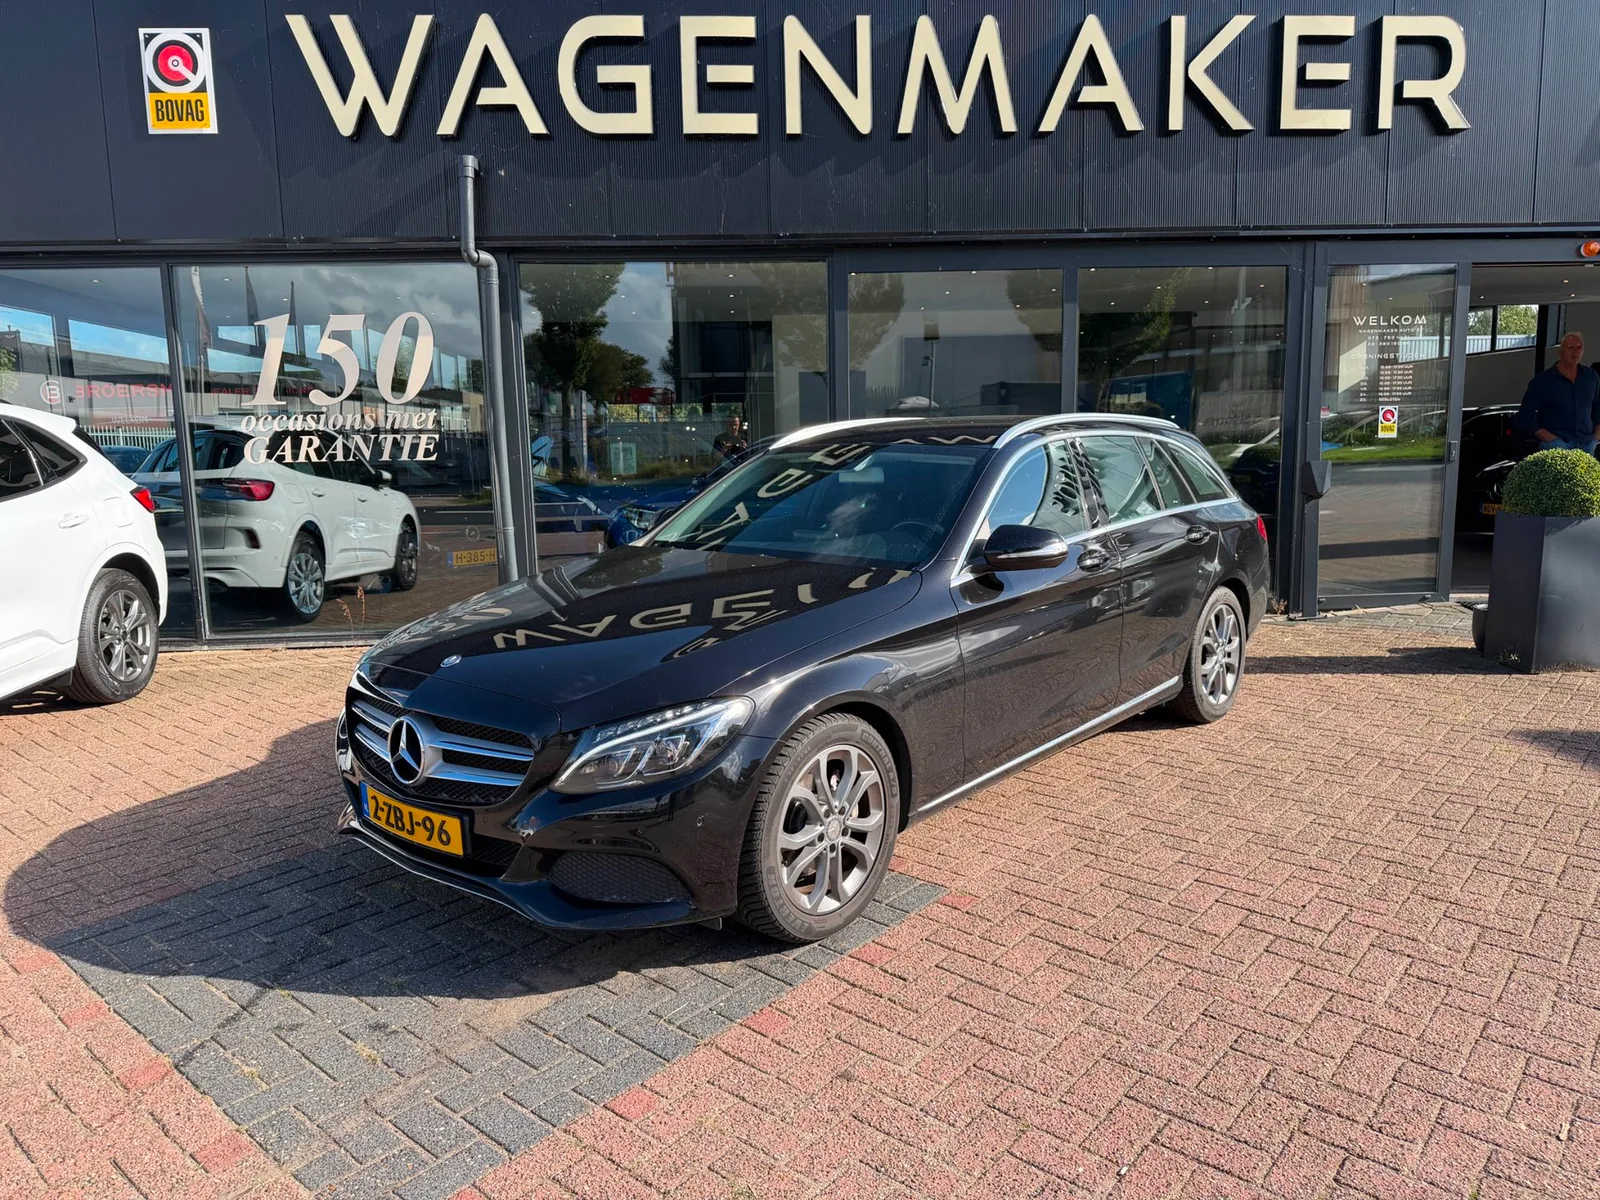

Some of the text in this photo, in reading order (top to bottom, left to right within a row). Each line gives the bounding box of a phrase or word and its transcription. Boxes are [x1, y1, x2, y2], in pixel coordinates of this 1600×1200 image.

[284, 14, 1471, 137] WAGENMAKER
[155, 99, 205, 122] BOVAG
[1353, 315, 1427, 326] WELKOM
[241, 311, 435, 406] 150
[241, 406, 437, 432] occasions met
[243, 434, 440, 464] GARANTIE
[371, 794, 451, 846] 2-ZBJ-96
